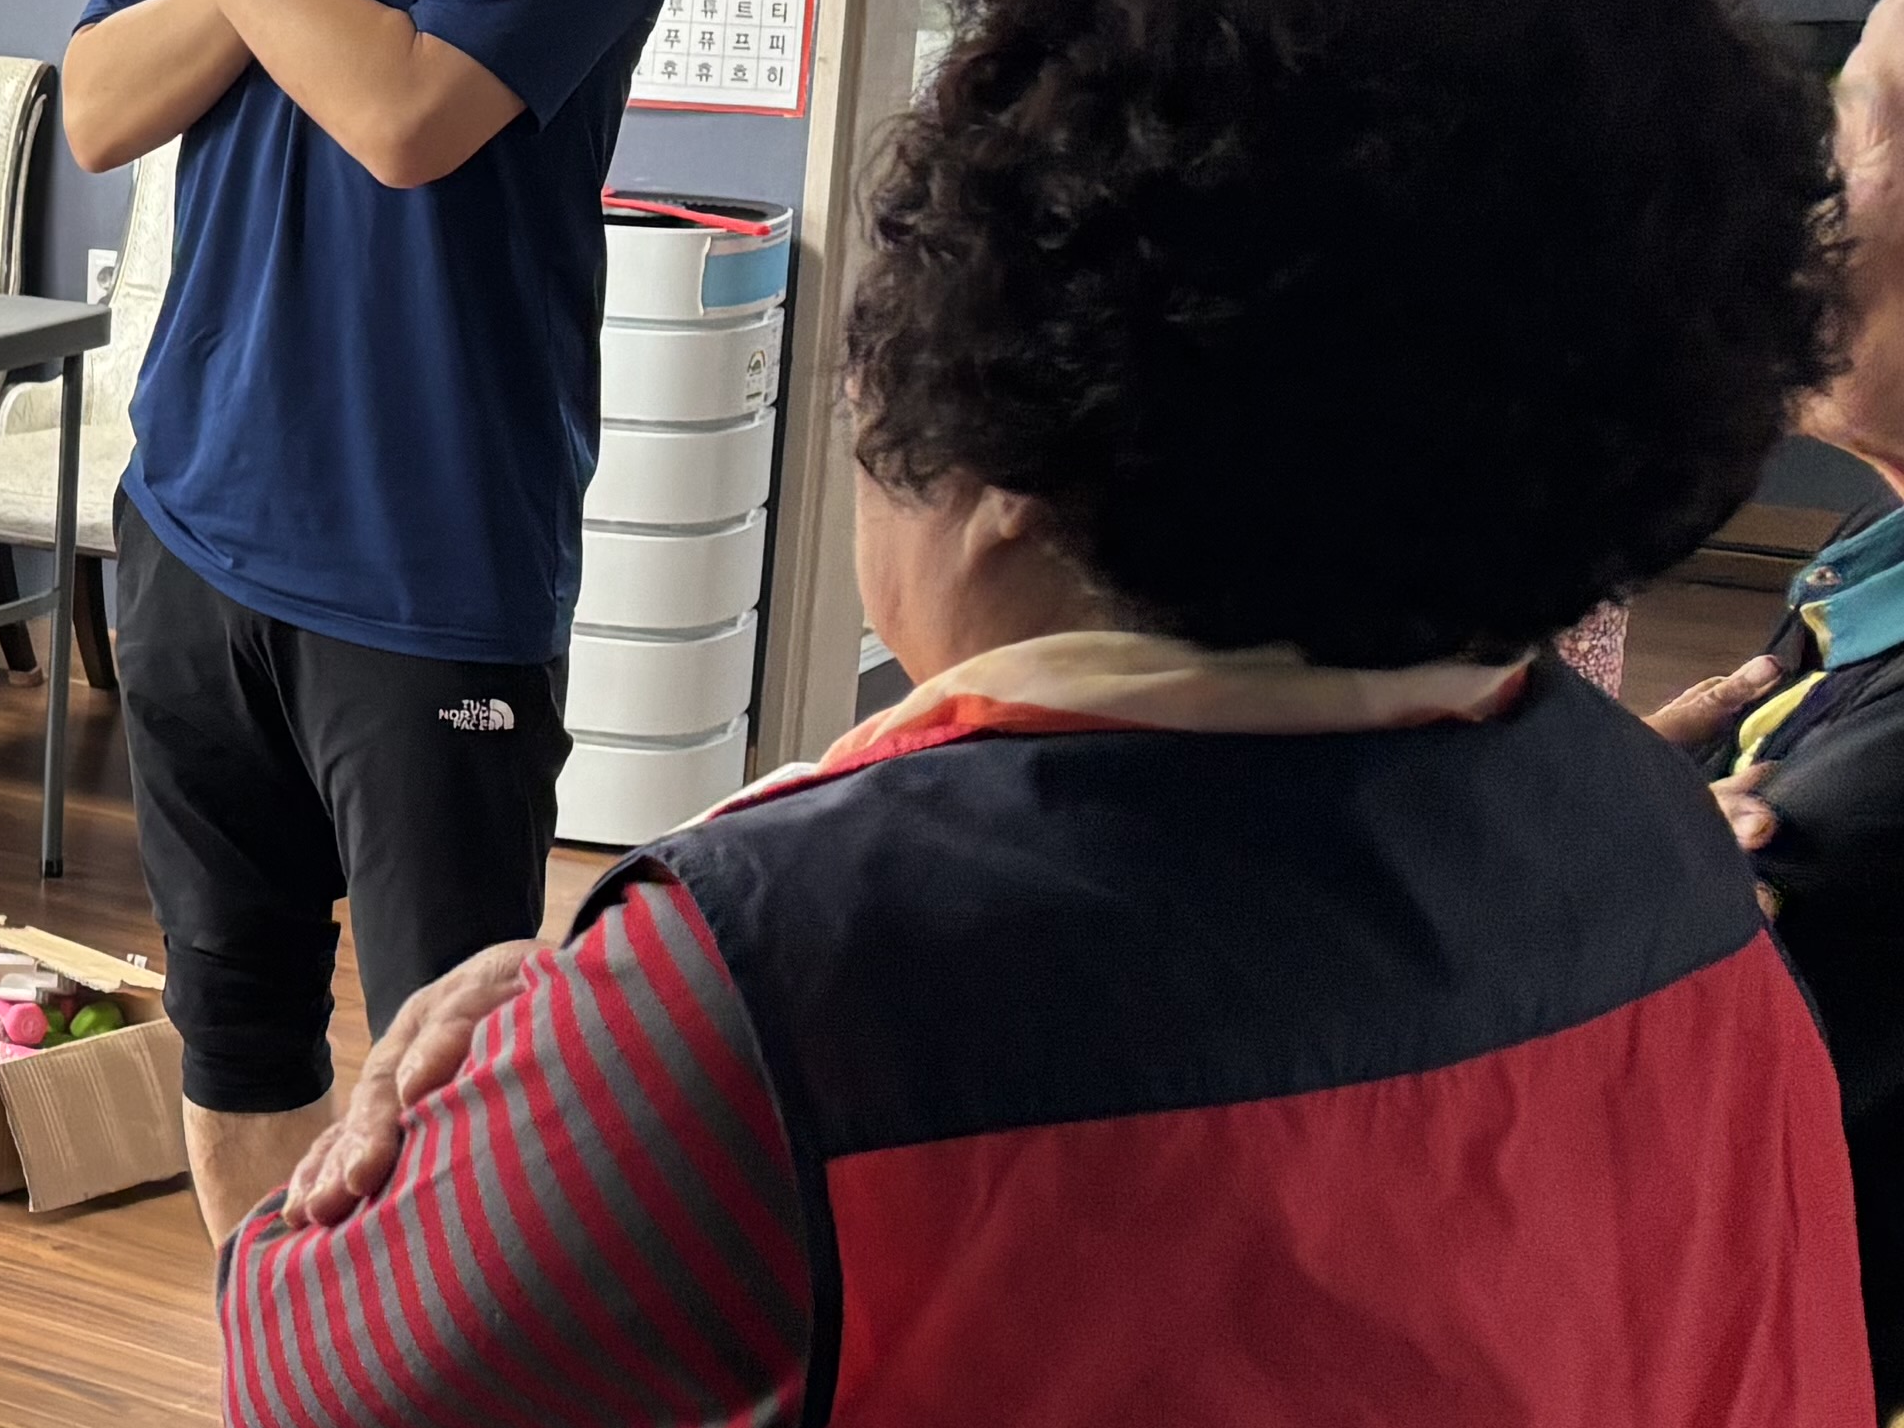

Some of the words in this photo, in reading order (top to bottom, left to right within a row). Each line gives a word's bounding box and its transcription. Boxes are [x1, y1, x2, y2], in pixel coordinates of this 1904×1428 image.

[701, 0, 717, 19] 튜
[736, 1, 753, 18] 트
[772, 3, 787, 23] 티
[664, 29, 680, 48] 푸
[699, 31, 715, 51] 퓨
[733, 33, 750, 50] 프
[769, 35, 785, 55] 피
[661, 60, 677, 79] 후
[696, 63, 712, 82] 휴
[731, 65, 748, 82] 흐
[767, 66, 783, 86] 히
[438, 708, 489, 721] NORTH
[453, 719, 488, 731] FACE
